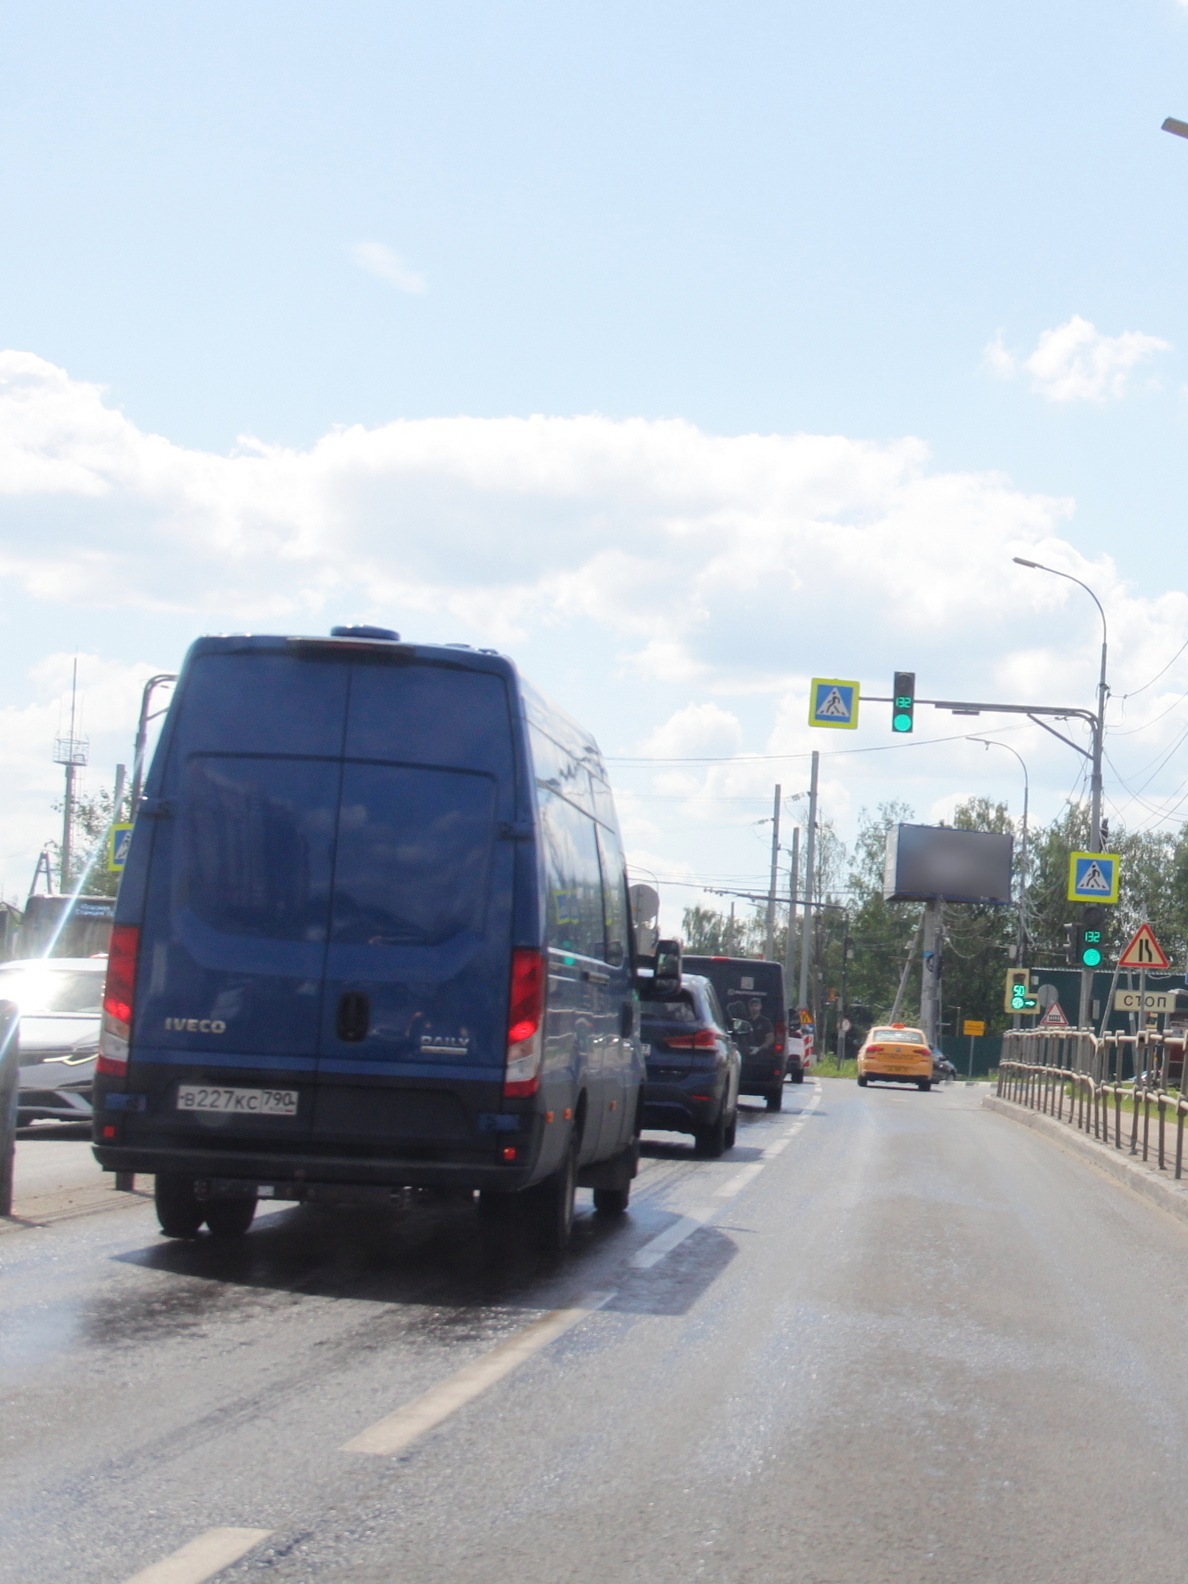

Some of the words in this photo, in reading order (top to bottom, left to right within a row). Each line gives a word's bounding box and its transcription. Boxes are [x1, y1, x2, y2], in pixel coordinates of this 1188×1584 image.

[895, 696, 912, 709] 132
[1084, 931, 1100, 943] 132
[165, 1017, 227, 1034] IVECO
[421, 1035, 470, 1047] DAILY
[264, 1091, 293, 1107] 790
